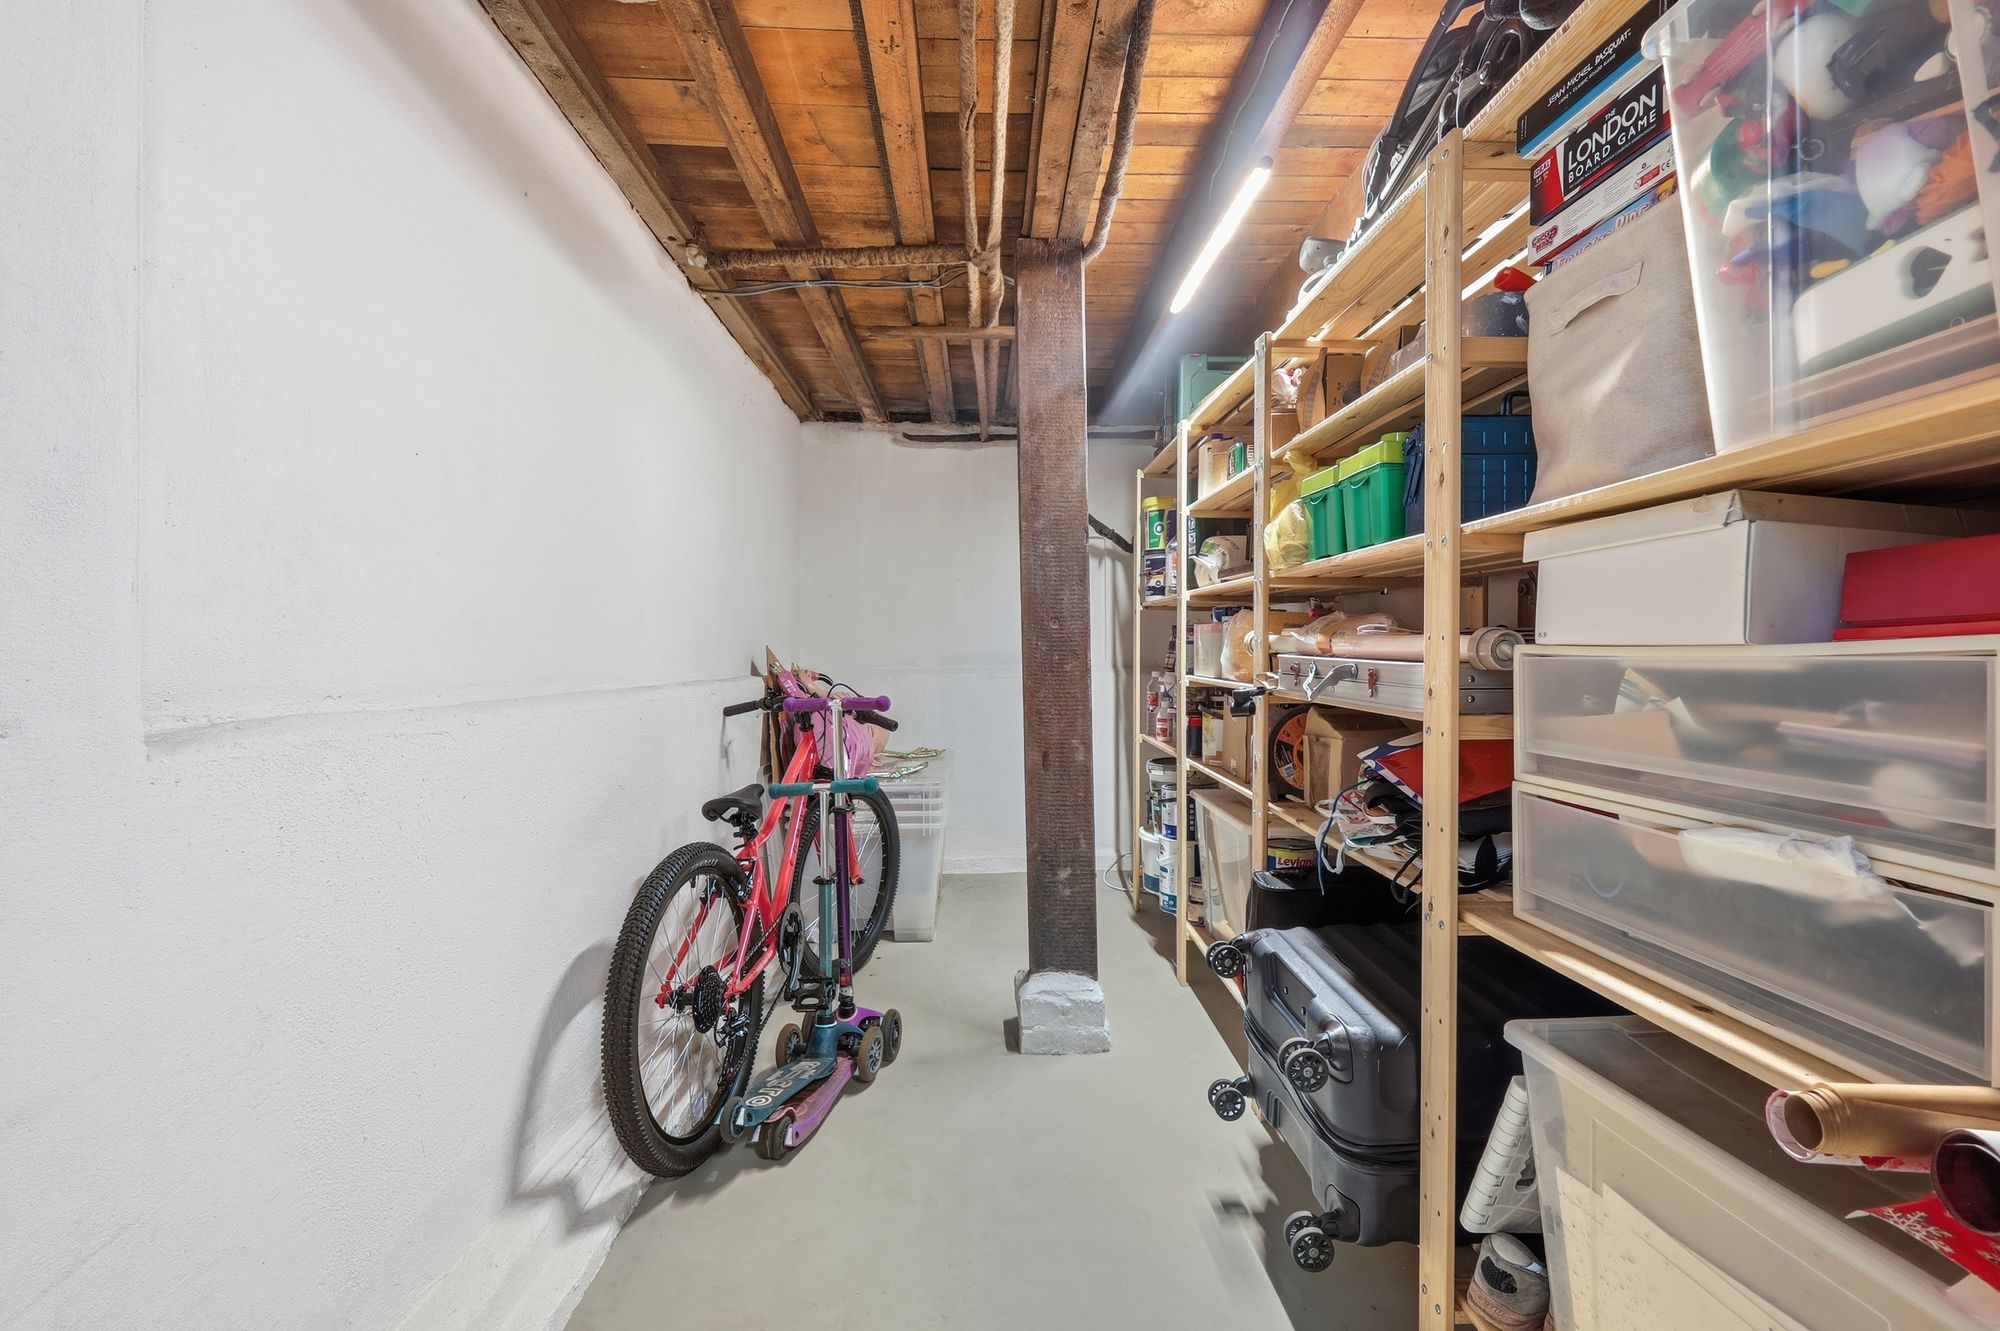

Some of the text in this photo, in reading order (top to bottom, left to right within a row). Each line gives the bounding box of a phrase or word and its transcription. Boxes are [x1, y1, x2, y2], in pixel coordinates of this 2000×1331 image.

[1547, 85, 1566, 107] JEAN
[1605, 108, 1616, 121] THE
[1568, 84, 1656, 171] LONDON
[1568, 145, 1610, 183] BOARD
[1617, 109, 1656, 145] GAME
